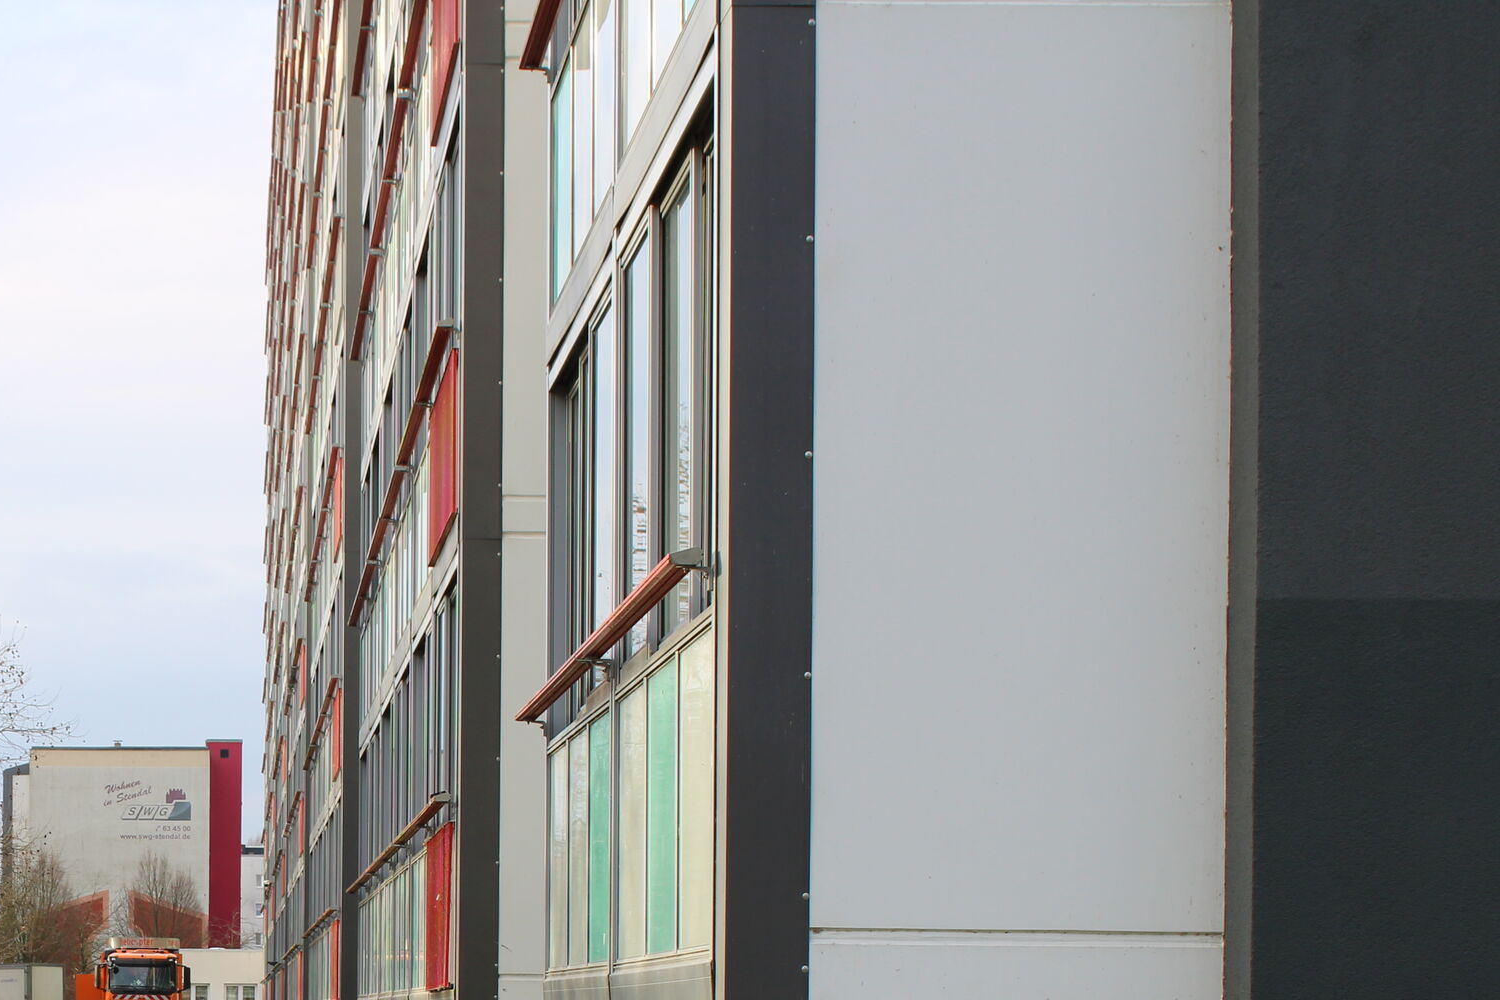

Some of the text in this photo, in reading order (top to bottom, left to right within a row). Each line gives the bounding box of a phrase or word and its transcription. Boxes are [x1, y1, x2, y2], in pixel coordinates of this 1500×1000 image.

[104, 780, 141, 794] Wohnen
[116, 786, 152, 803] Stendal
[128, 806, 169, 816] SWG
